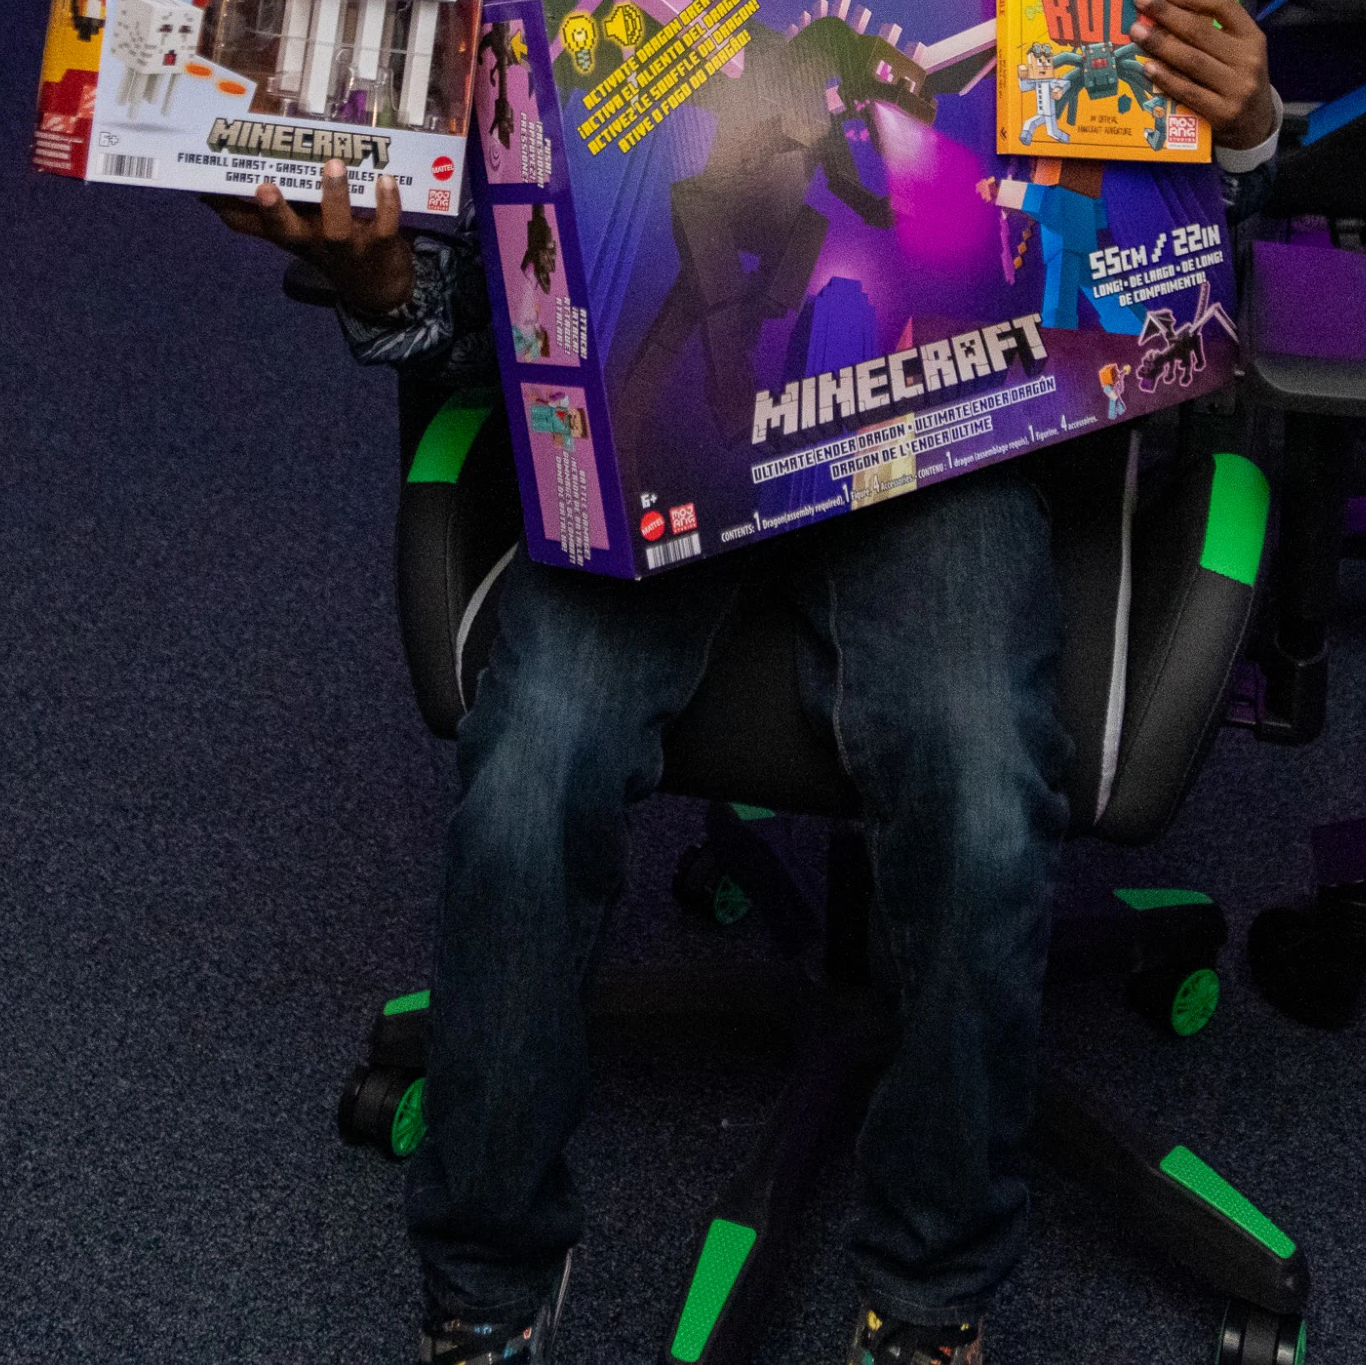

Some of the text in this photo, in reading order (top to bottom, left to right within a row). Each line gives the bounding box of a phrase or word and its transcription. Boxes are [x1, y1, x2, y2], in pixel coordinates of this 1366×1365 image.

[577, 94, 625, 139] ¡ACTIVA
[621, 82, 639, 102] EL
[636, 42, 685, 87] ALIENTO
[682, 22, 706, 47] DEL
[582, 55, 639, 110] ACTIVATE
[636, 17, 683, 63] DRAGON
[587, 106, 638, 156] ACTIVEZ
[635, 93, 653, 114] LE
[649, 51, 700, 101] SOUFFLE
[618, 117, 655, 154] ATIVE
[660, 84, 692, 116] FOGO
[1169, 117, 1195, 128] MOJ
[206, 117, 392, 170] MINECRAFT
[520, 112, 528, 183] PRESSIONE!
[544, 138, 552, 175] PUSH!
[1169, 127, 1195, 137] ANG
[177, 152, 229, 168] FIREBALL
[232, 157, 266, 171] GHAST
[275, 162, 318, 177] GHASTS
[346, 169, 375, 182] ULES
[225, 171, 260, 184] GHAST
[279, 177, 313, 190] BOLAS
[431, 164, 455, 174] MATTEL
[1088, 244, 1148, 280] 55CM
[1171, 223, 1221, 257] 22IN
[1093, 250, 1224, 299] LONG! DE LARGO DE LONG!
[1118, 270, 1207, 307] DE COMPRIMENTO!
[579, 308, 587, 360] ATTACK!
[751, 312, 1049, 445] MINECRAFT
[752, 375, 1057, 484] ULTIMATE ENDER DRAGON ULTIMATE ENDER DRAGÓN
[830, 416, 993, 481] DRAGON DE L'ENDER ULTIME
[640, 494, 657, 509] 6+
[721, 523, 755, 543] CONTENTS:
[753, 511, 761, 531] 1
[842, 484, 851, 503] 1
[872, 475, 880, 493] 4
[945, 451, 953, 469] 1
[1028, 425, 1036, 443] 1
[1060, 414, 1068, 431] 4
